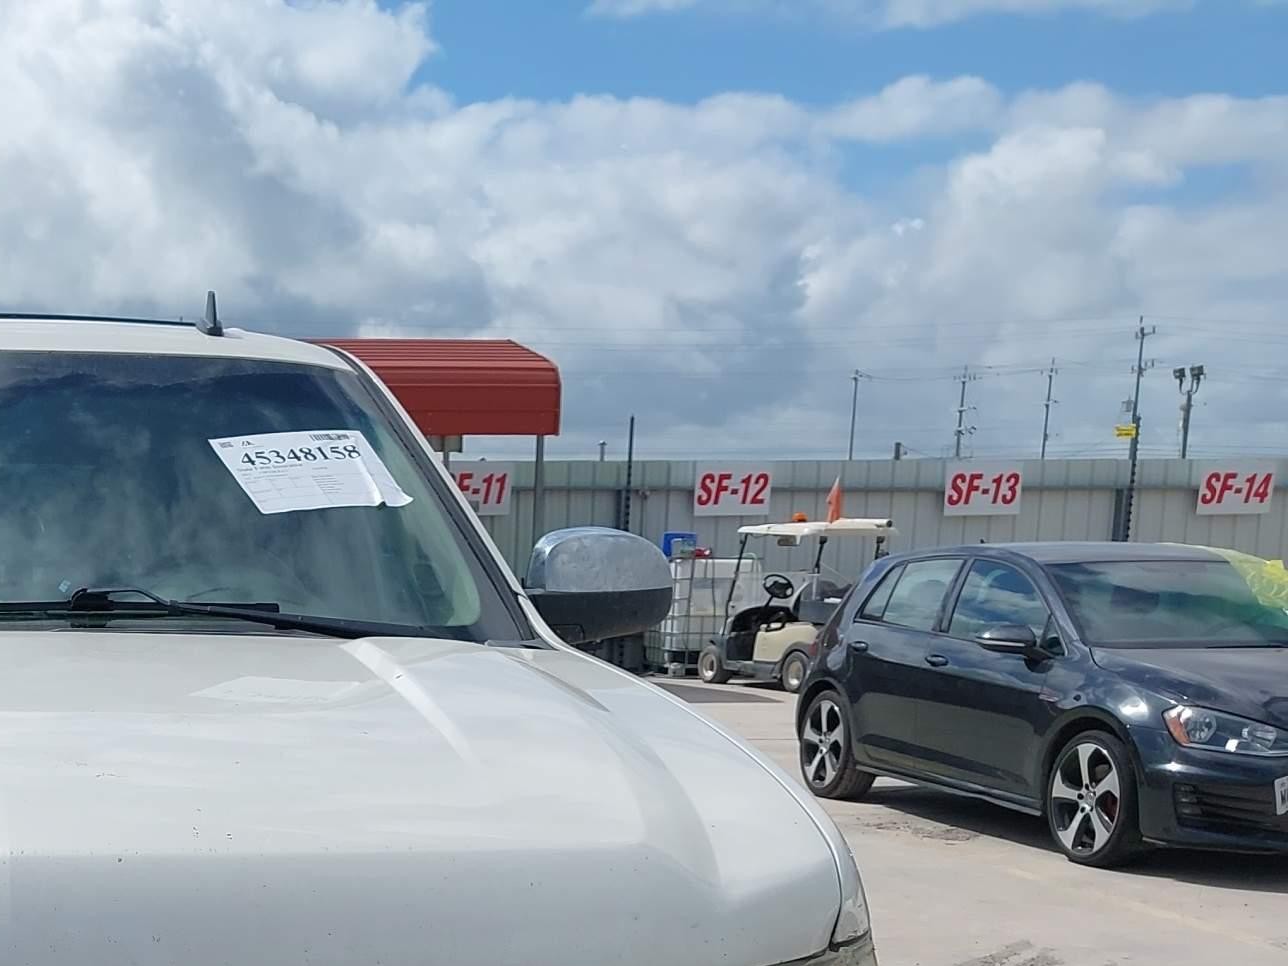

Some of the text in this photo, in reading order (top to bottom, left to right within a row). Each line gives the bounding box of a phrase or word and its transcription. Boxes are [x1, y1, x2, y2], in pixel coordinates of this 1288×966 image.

[240, 444, 362, 466] 45348158
[454, 472, 508, 505] F-11
[697, 471, 772, 507] SF-12
[946, 471, 1021, 506] SF-13
[1199, 471, 1275, 505] SF-14
